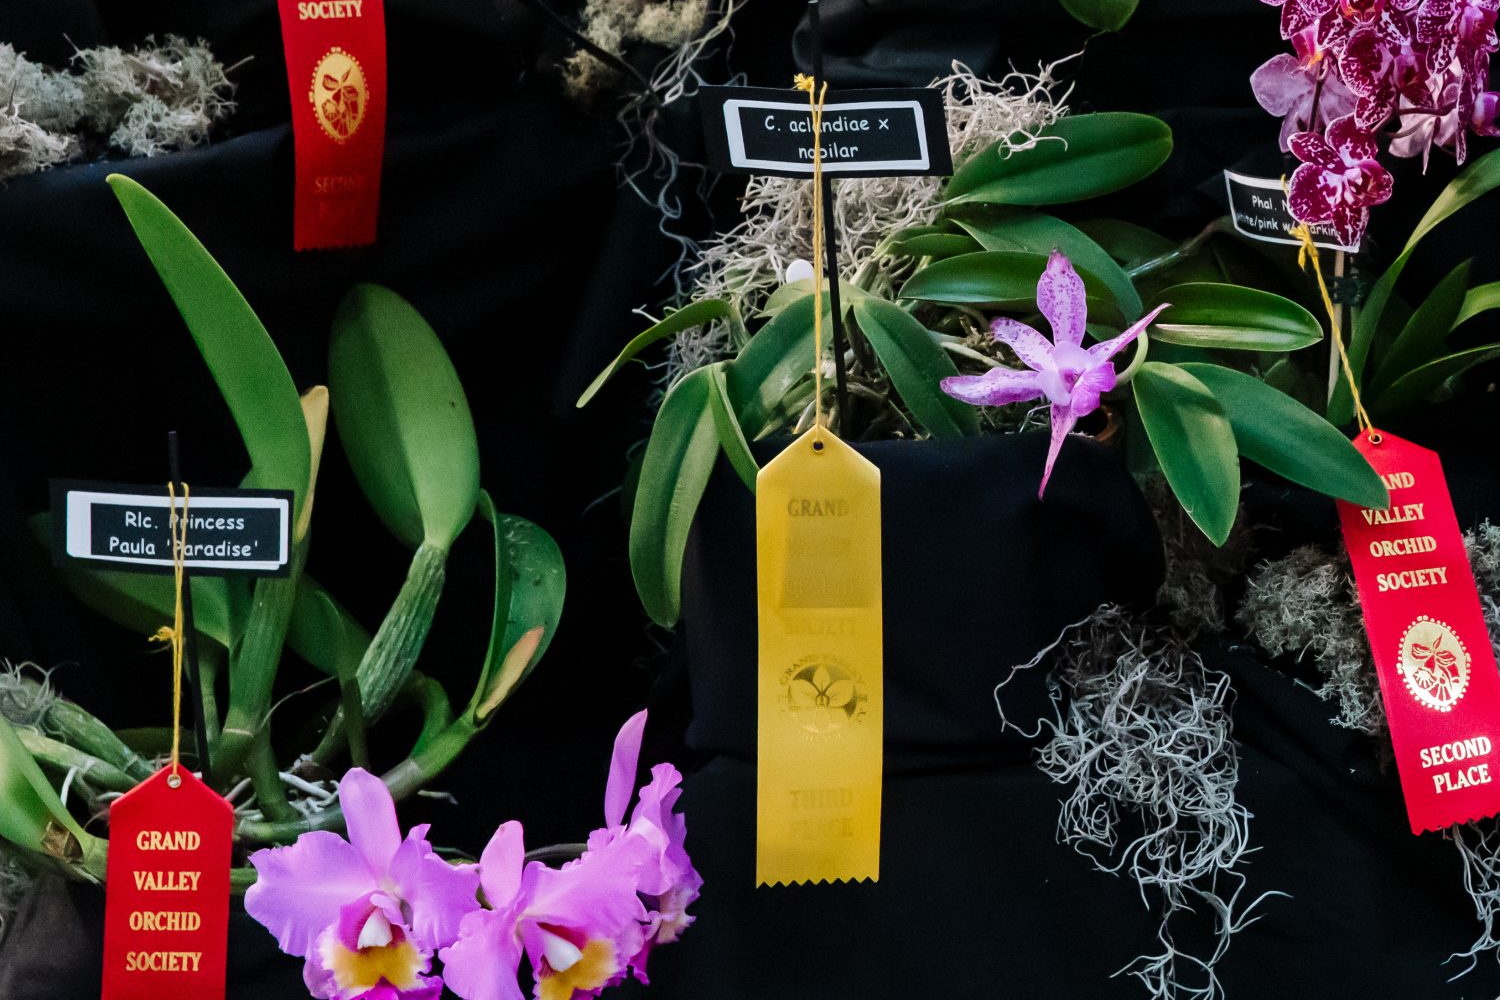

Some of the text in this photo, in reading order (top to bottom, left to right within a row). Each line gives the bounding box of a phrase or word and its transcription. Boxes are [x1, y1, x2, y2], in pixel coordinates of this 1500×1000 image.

[297, 0, 363, 20] SOCIETY
[764, 114, 781, 132] C.
[878, 118, 889, 130] x
[1252, 195, 1278, 211] Phal.
[787, 498, 850, 517] GRAND
[1361, 502, 1425, 526] VALLEY
[125, 511, 245, 531] Rlc. Princess
[109, 536, 258, 557] Paula 'Paradise'
[1369, 535, 1437, 558] ORCHID
[1376, 566, 1448, 592] SOCIETY
[1419, 735, 1492, 769] SECOND
[1432, 763, 1492, 794] PLACE
[136, 830, 201, 851] GRAND
[133, 871, 201, 891] VALLEY
[129, 911, 201, 931] ORCHID
[126, 951, 202, 972] SOCIETY
